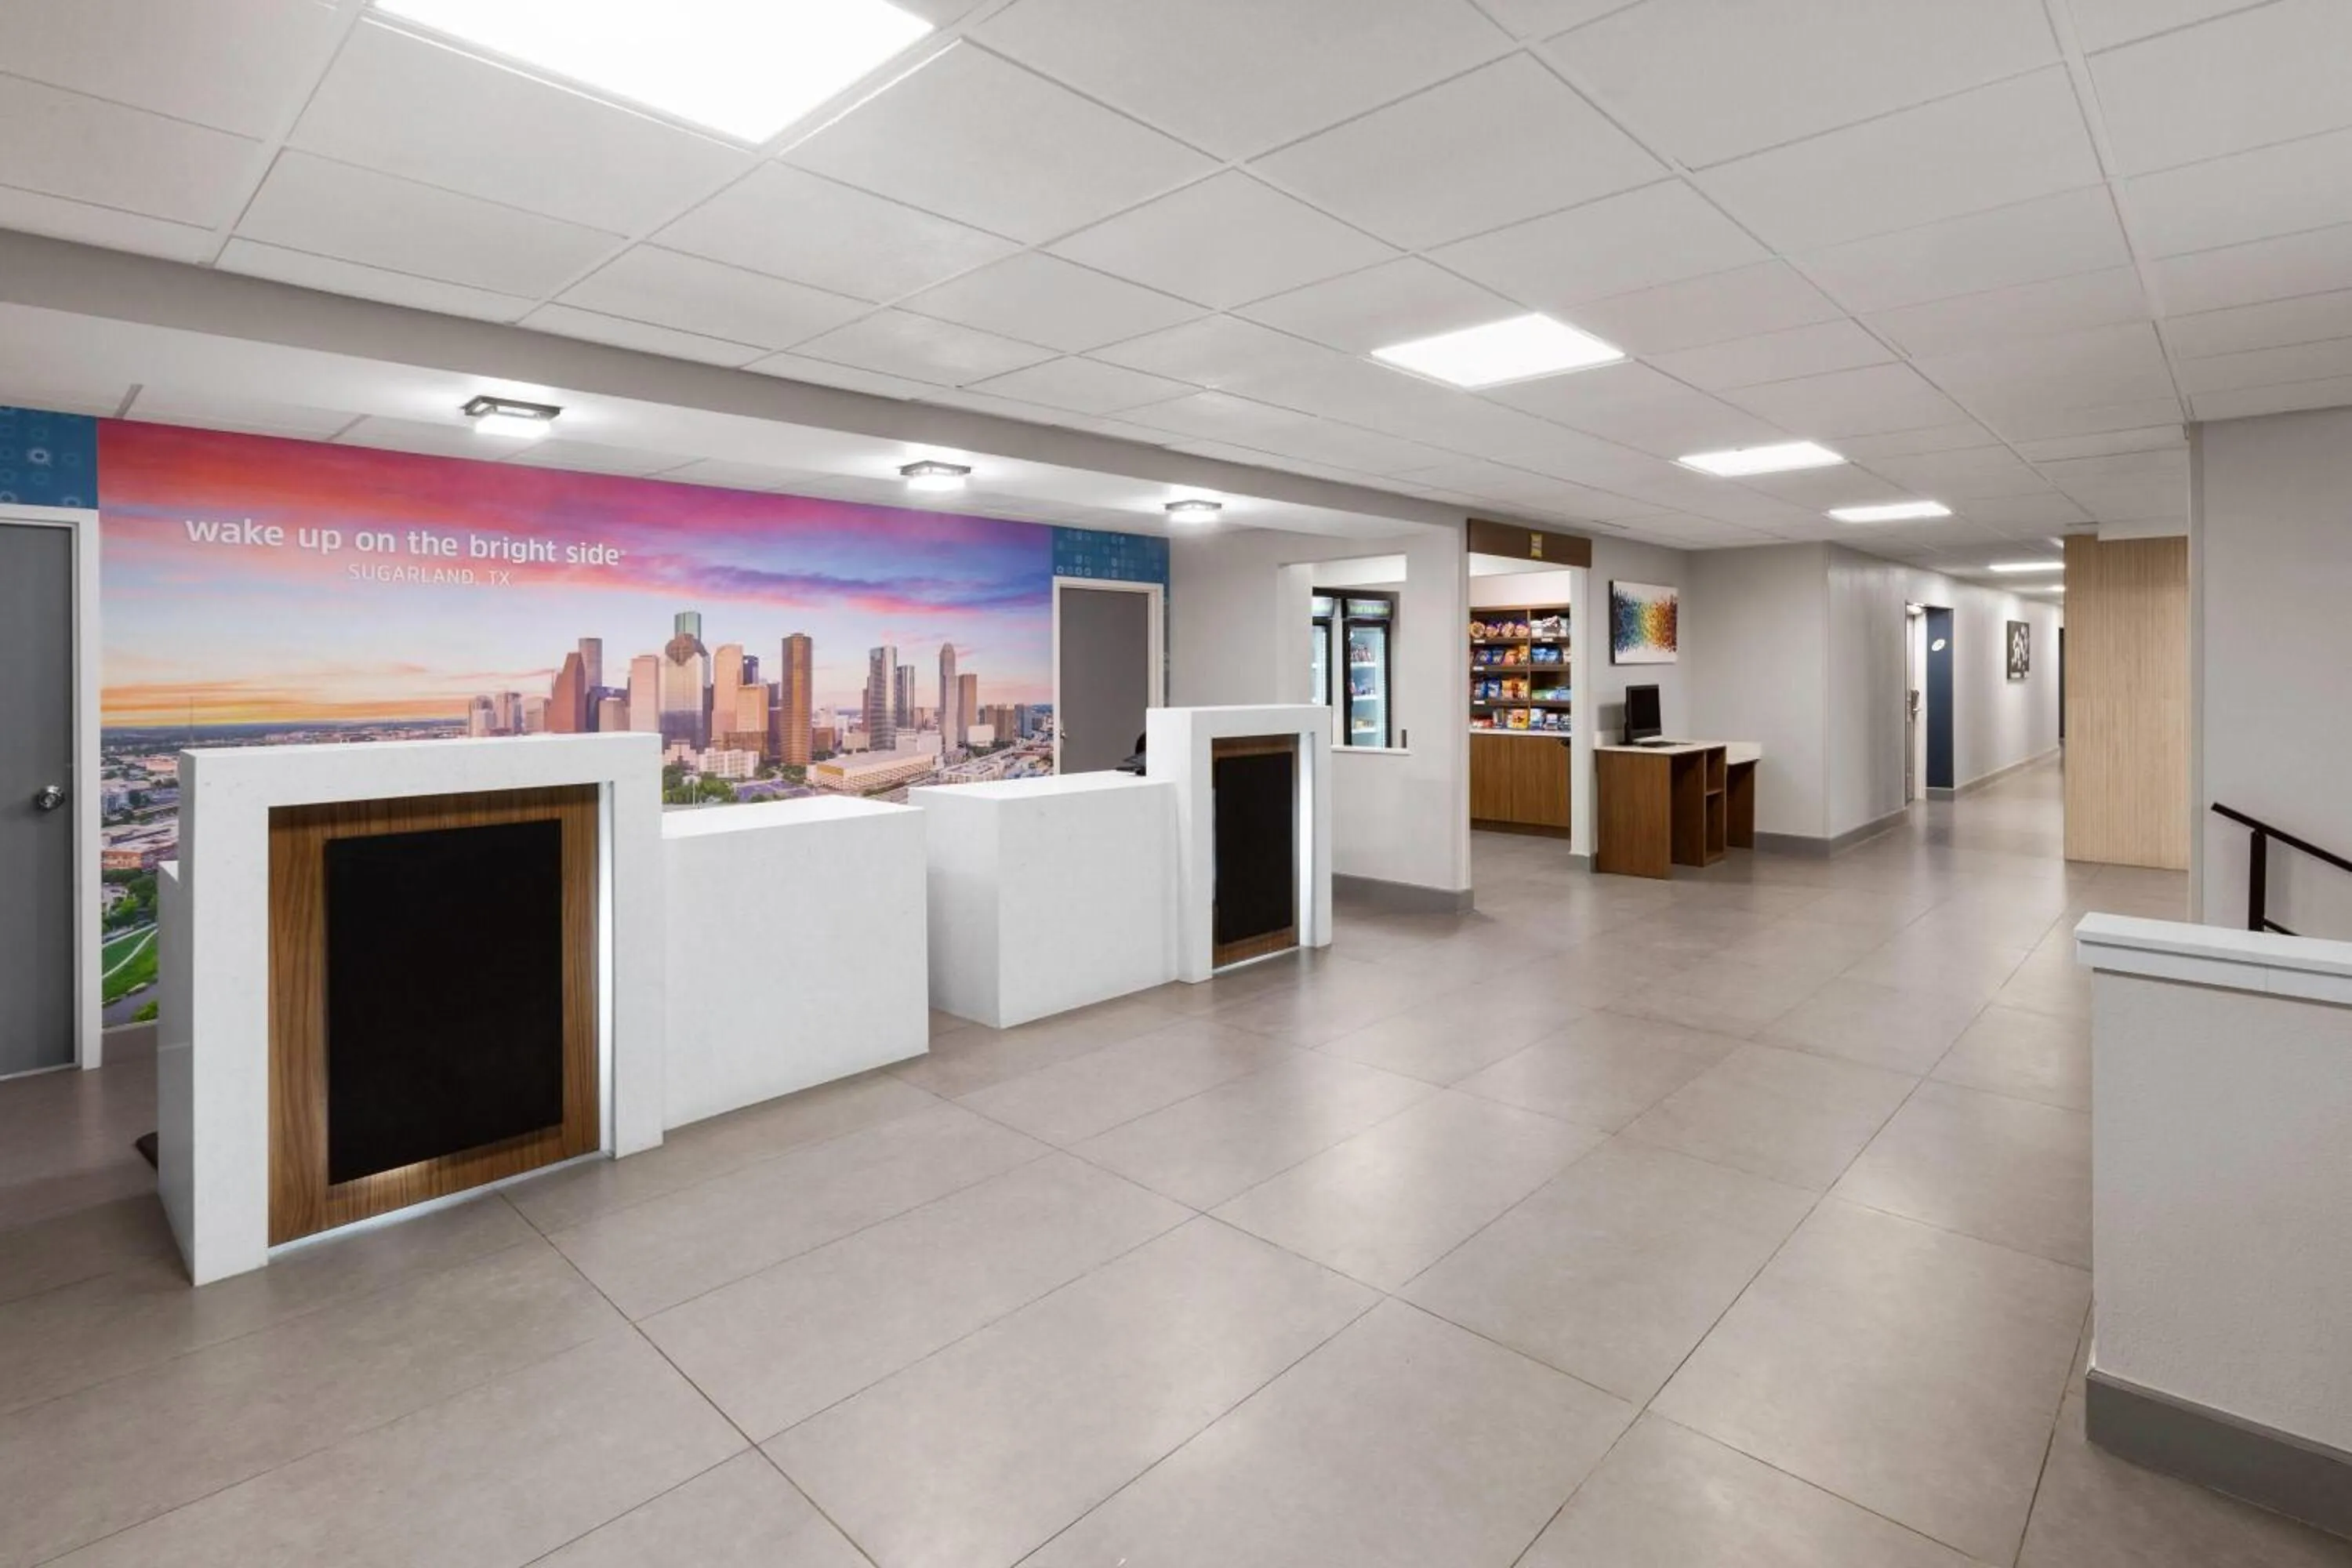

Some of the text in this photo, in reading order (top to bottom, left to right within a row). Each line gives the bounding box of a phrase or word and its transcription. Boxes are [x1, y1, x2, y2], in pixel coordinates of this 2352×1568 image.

[185, 518, 619, 565] wake up on the bright side
[348, 563, 510, 586] SUGARLAND, TX
